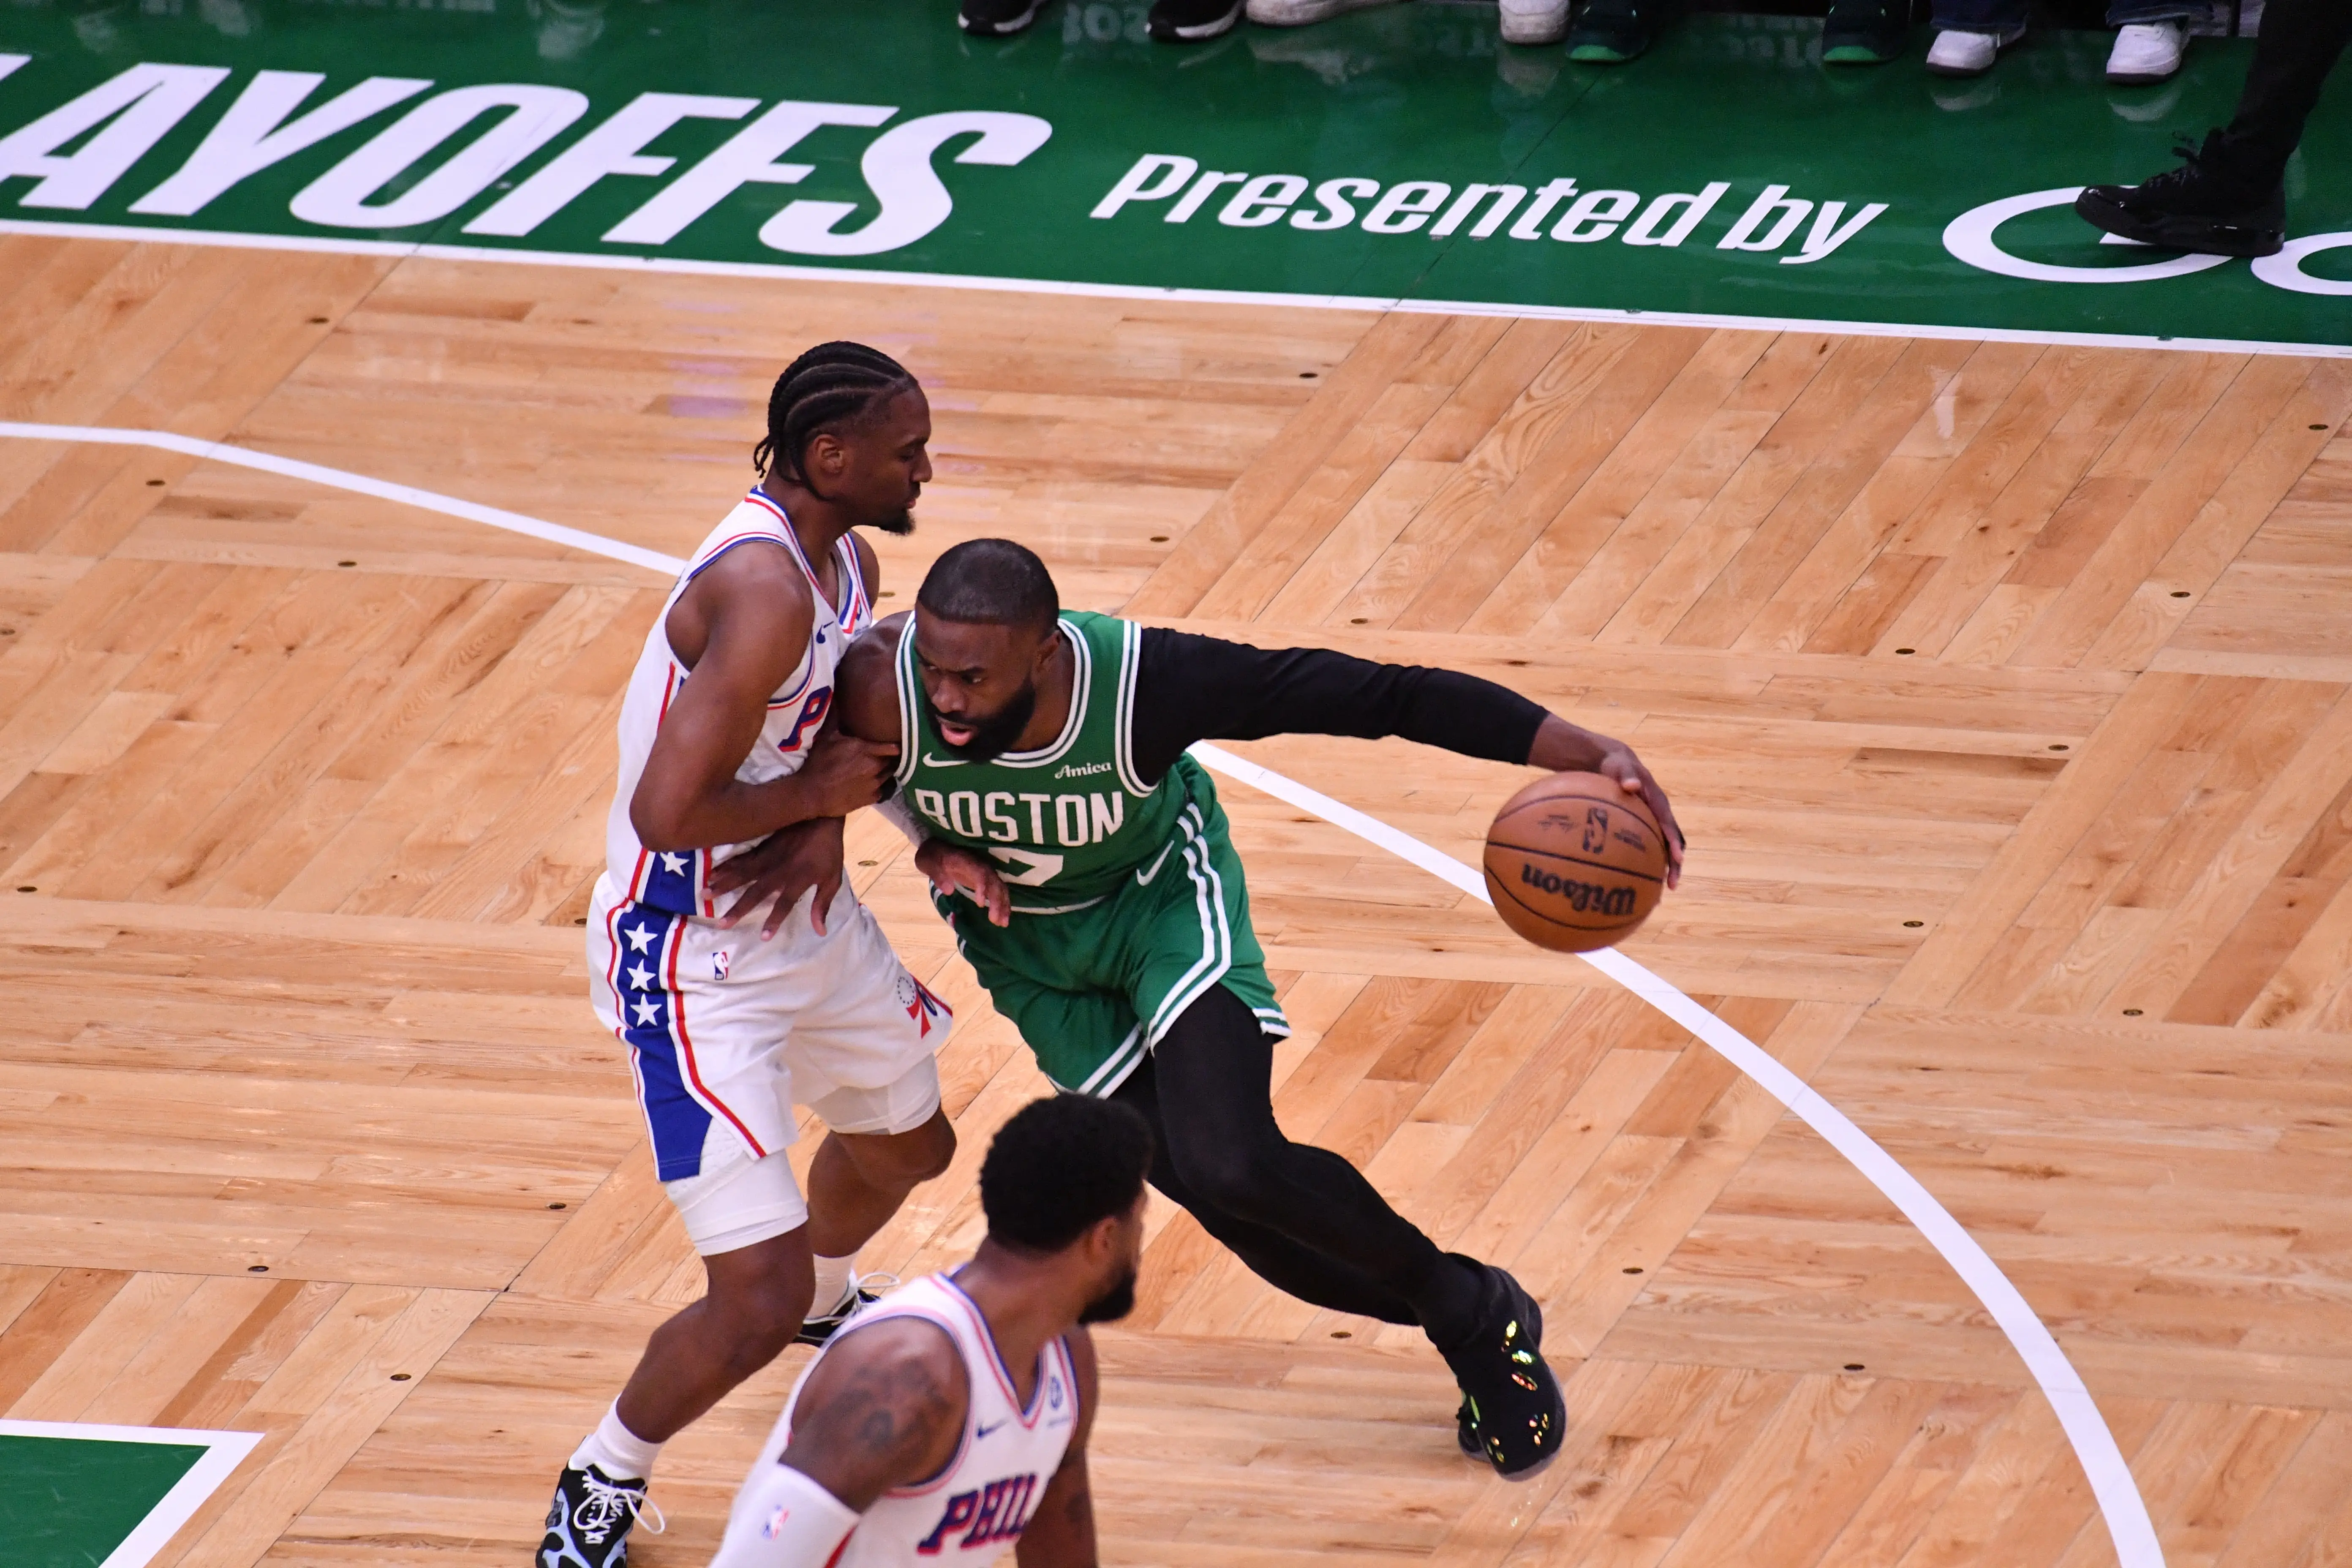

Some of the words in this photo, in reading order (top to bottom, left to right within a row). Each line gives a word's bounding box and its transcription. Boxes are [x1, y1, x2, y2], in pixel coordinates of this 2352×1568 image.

[0, 53, 1053, 255] AYOFFS
[1090, 154, 1731, 247] Presented
[1715, 184, 1889, 264] by
[1054, 761, 1112, 779] Amica
[914, 788, 1124, 847] BOSTON
[988, 847, 1064, 887] 7
[1522, 863, 1637, 916] Wilson
